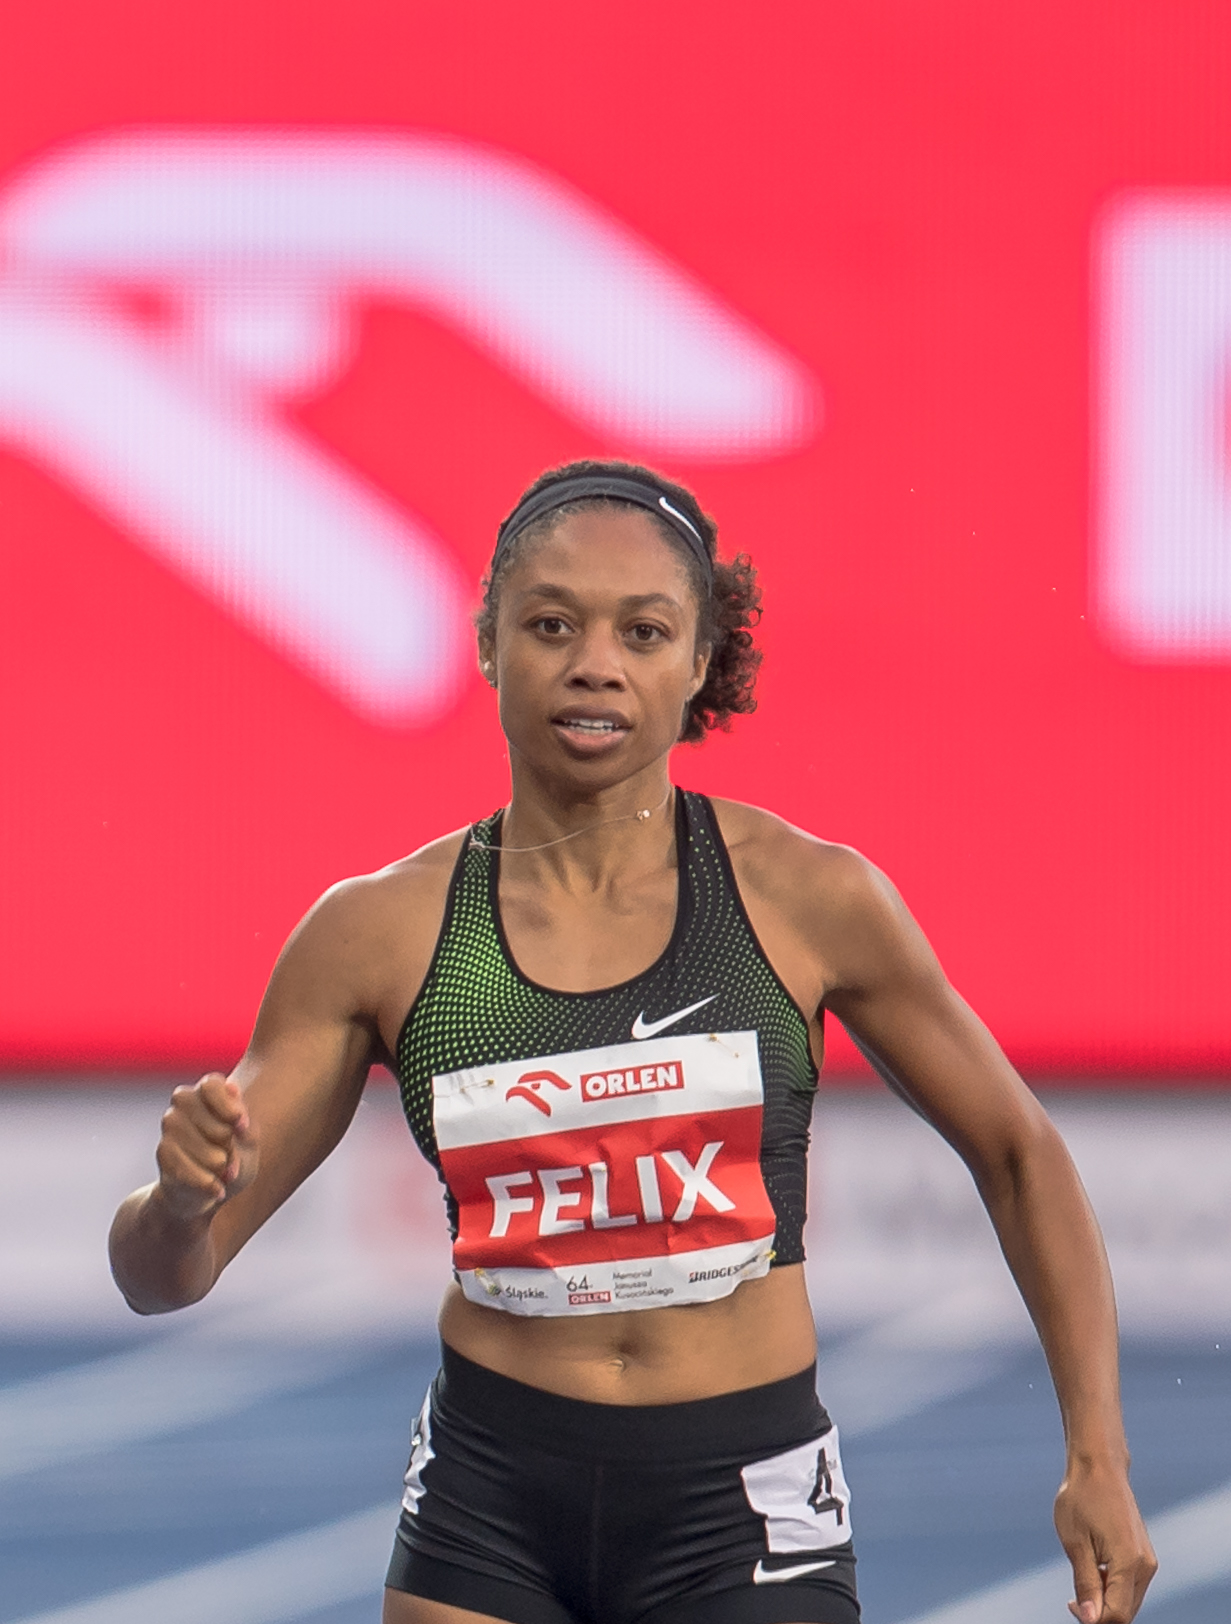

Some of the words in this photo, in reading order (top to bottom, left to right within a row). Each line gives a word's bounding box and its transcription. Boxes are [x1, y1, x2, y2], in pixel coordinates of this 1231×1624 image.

[584, 1063, 679, 1099] ORLEN
[484, 1141, 736, 1238] FELIX
[571, 1291, 610, 1304] ORLEN
[807, 1447, 844, 1527] 4
